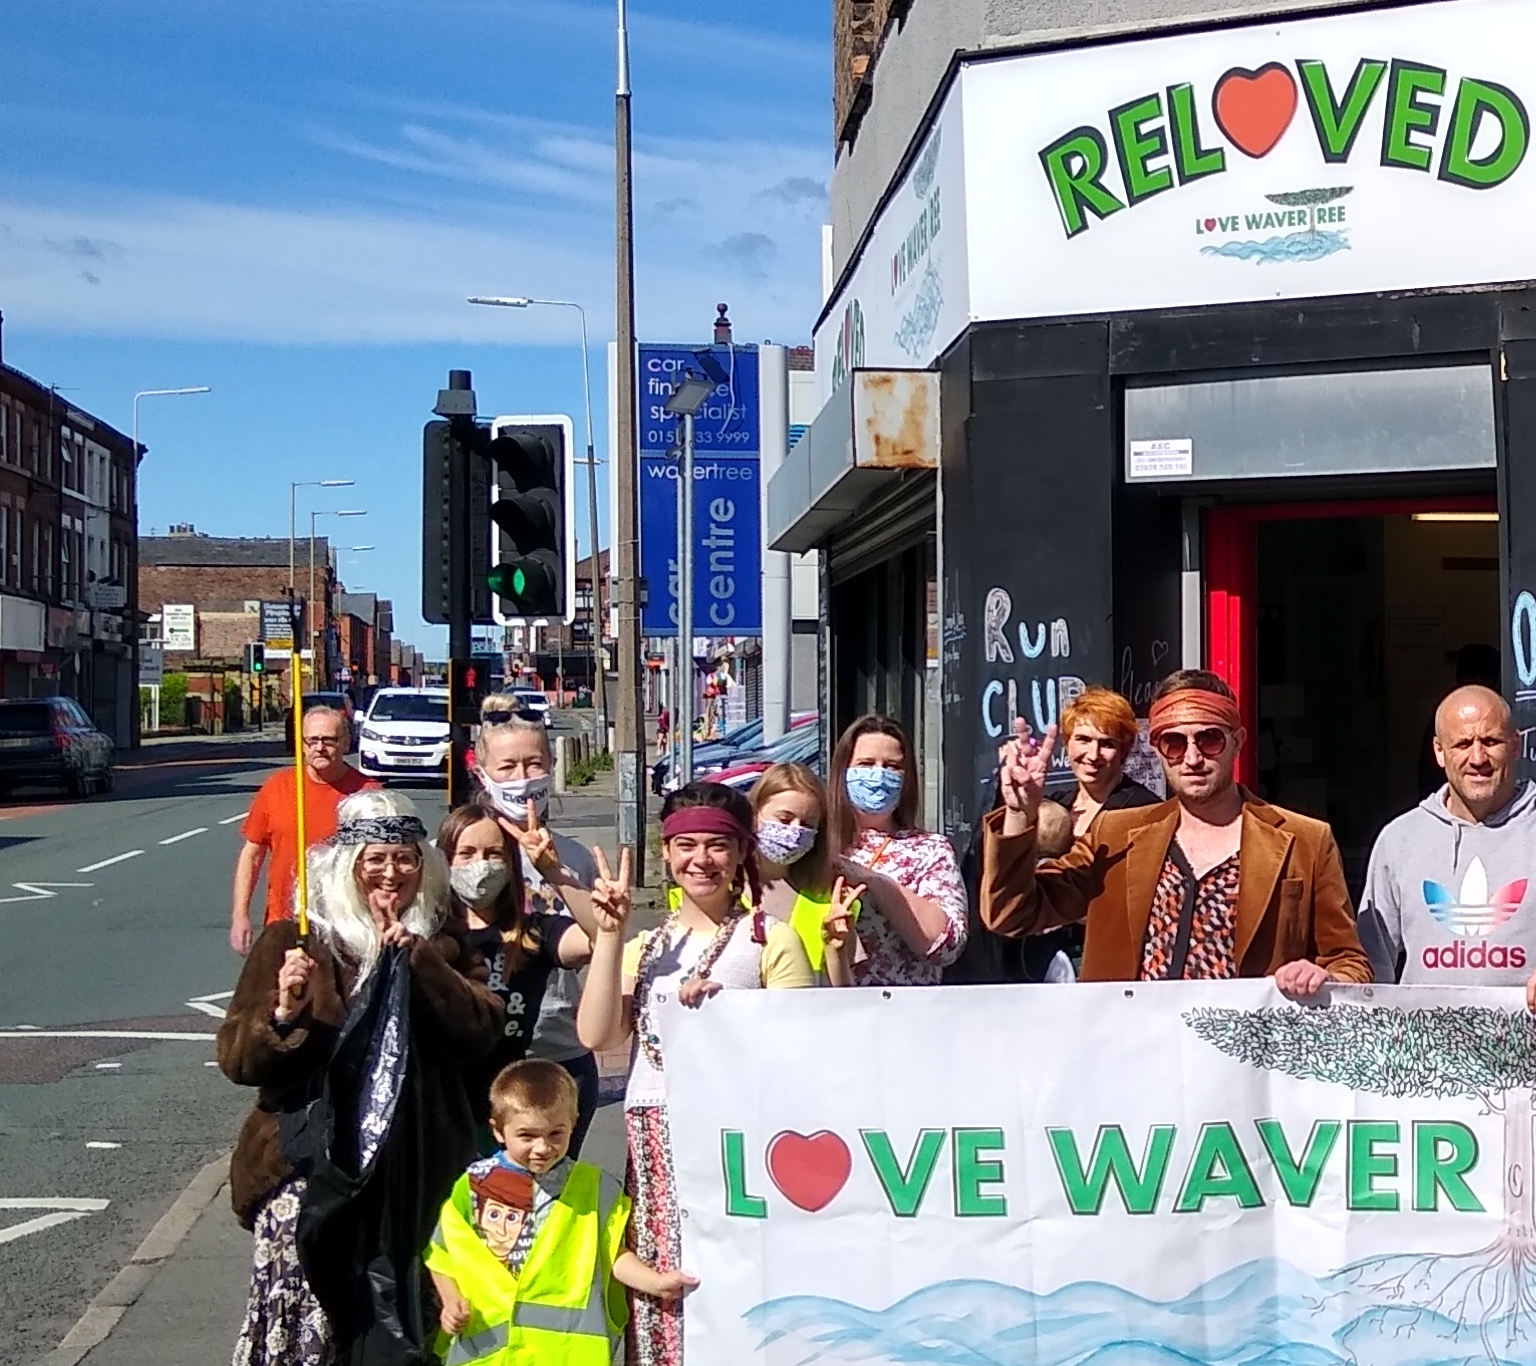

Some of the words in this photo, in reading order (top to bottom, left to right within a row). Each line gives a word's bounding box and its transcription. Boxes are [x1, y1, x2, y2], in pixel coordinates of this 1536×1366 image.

[647, 358, 685, 372] car
[648, 377, 729, 397] fine
[650, 402, 747, 423] spialist
[717, 432, 750, 444] 9999
[648, 463, 752, 480] waertree
[702, 497, 735, 626] centre
[985, 587, 1070, 663] Run
[1422, 939, 1526, 969] adidas
[506, 991, 526, 1015] &
